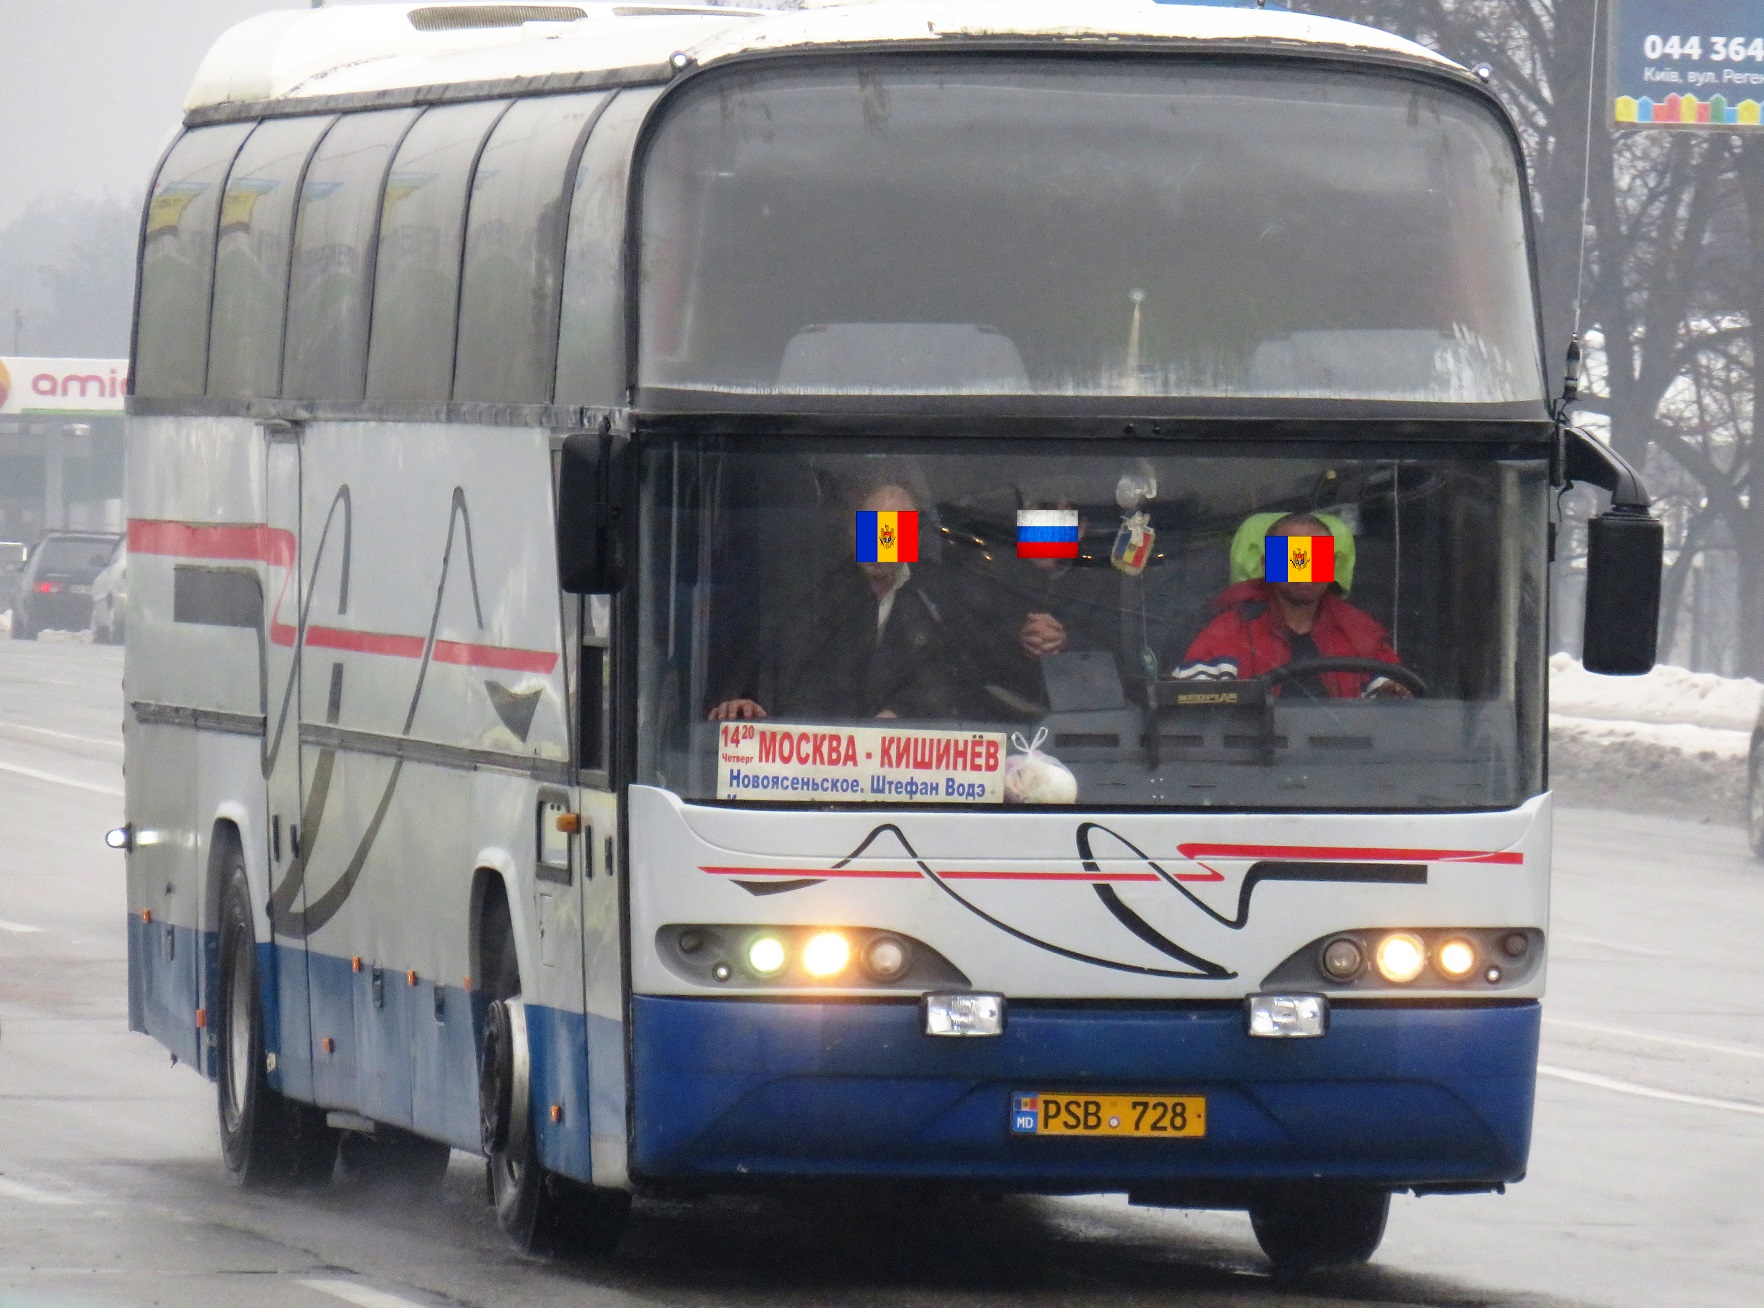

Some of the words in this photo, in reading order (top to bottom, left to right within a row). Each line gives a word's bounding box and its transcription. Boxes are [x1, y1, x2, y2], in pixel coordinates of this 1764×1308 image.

[1644, 34, 1702, 60] 044
[1710, 36, 1764, 62] 364
[1687, 71, 1719, 87] вул.
[721, 752, 754, 765] Четверг
[758, 730, 858, 767] МОСКВА
[879, 734, 999, 772] КИШИНЁВ
[870, 775, 939, 800] Штефан
[945, 777, 986, 801] Водэ
[1016, 1117, 1034, 1129] MD
[1042, 1099, 1102, 1131] PSB
[1131, 1101, 1187, 1132] 728
